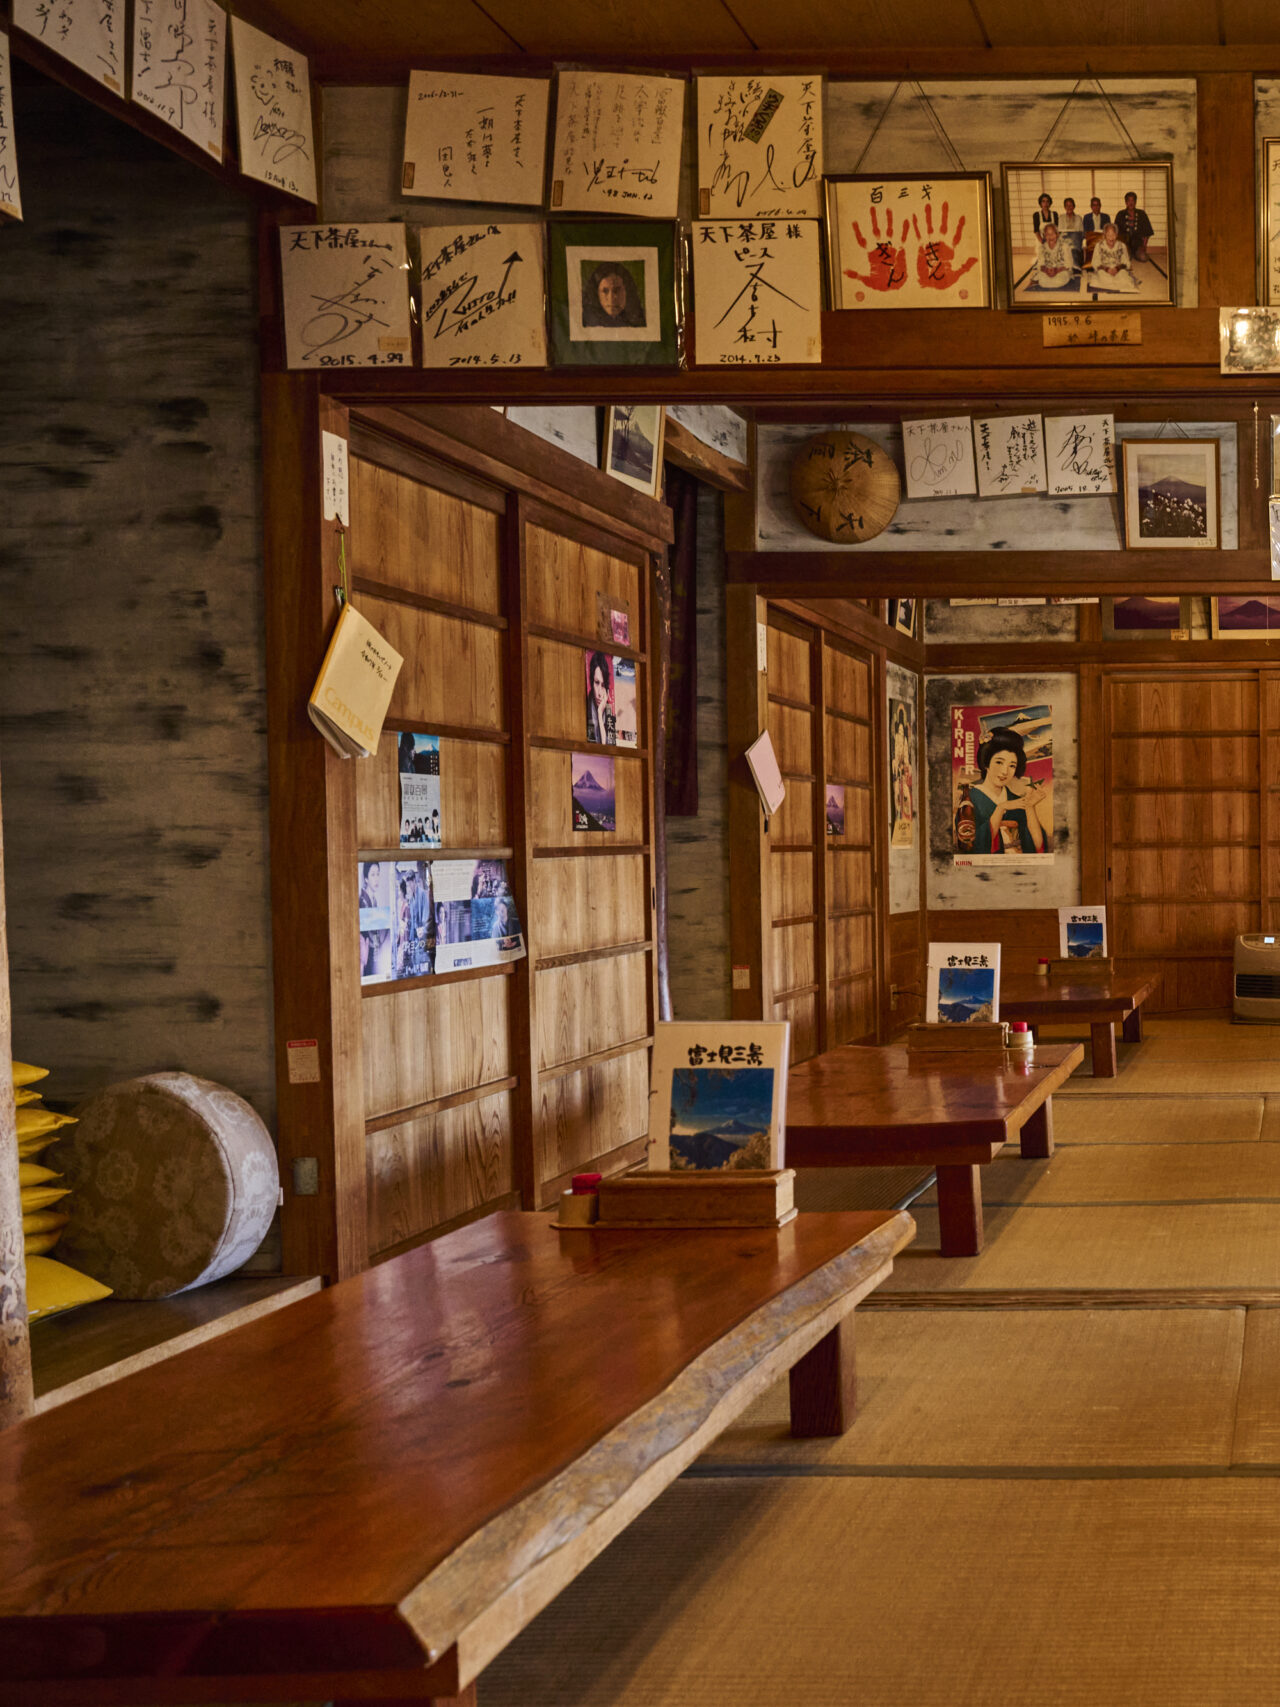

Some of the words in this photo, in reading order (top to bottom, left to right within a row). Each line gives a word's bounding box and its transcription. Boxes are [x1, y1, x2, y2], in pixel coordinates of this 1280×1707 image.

[324, 686, 376, 742] Campus
[953, 708, 964, 758] KIRIN
[965, 731, 976, 776] BEER
[954, 859, 974, 867] KIRIN
[688, 1042, 765, 1067] 富士見三景
